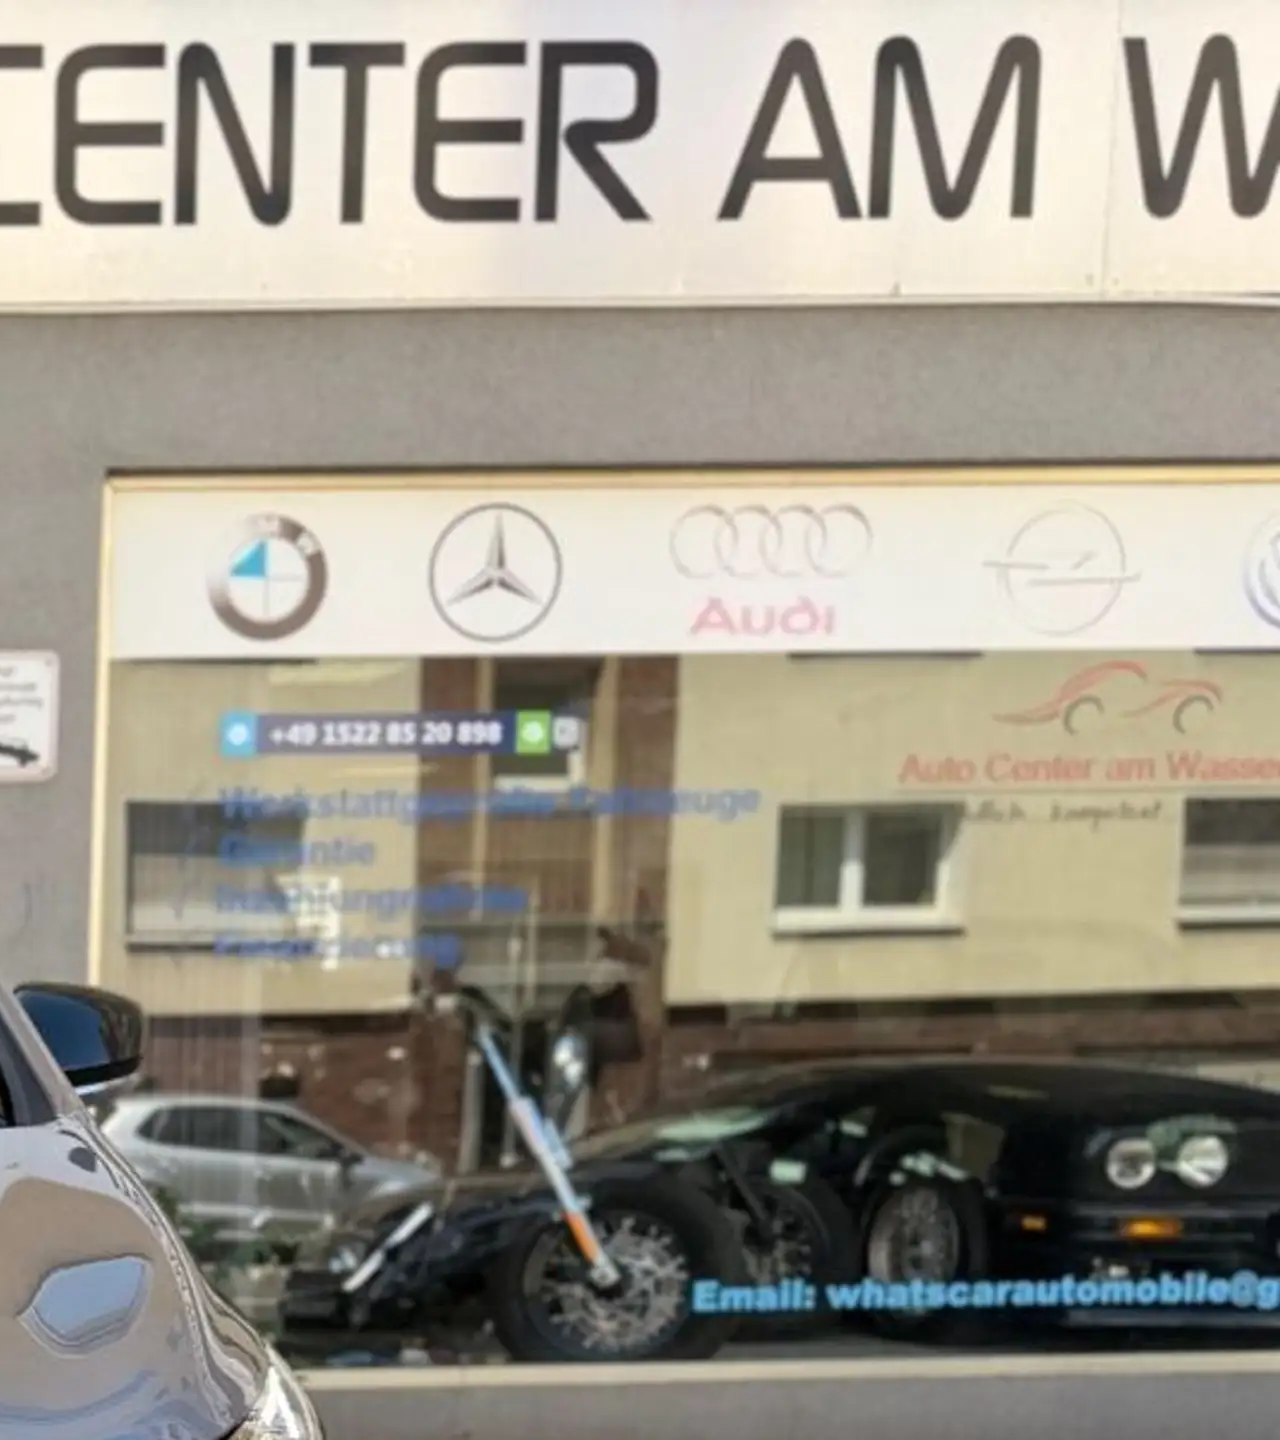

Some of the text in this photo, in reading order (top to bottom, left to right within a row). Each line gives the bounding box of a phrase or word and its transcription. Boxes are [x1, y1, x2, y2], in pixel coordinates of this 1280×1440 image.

[716, 33, 1042, 223] AM
[689, 595, 836, 637] Audi
[268, 721, 317, 747] +49
[420, 720, 453, 745] 20
[897, 753, 977, 785] Auto
[984, 751, 1094, 784] Center
[1105, 757, 1157, 783] am
[693, 1277, 817, 1313] Email:
